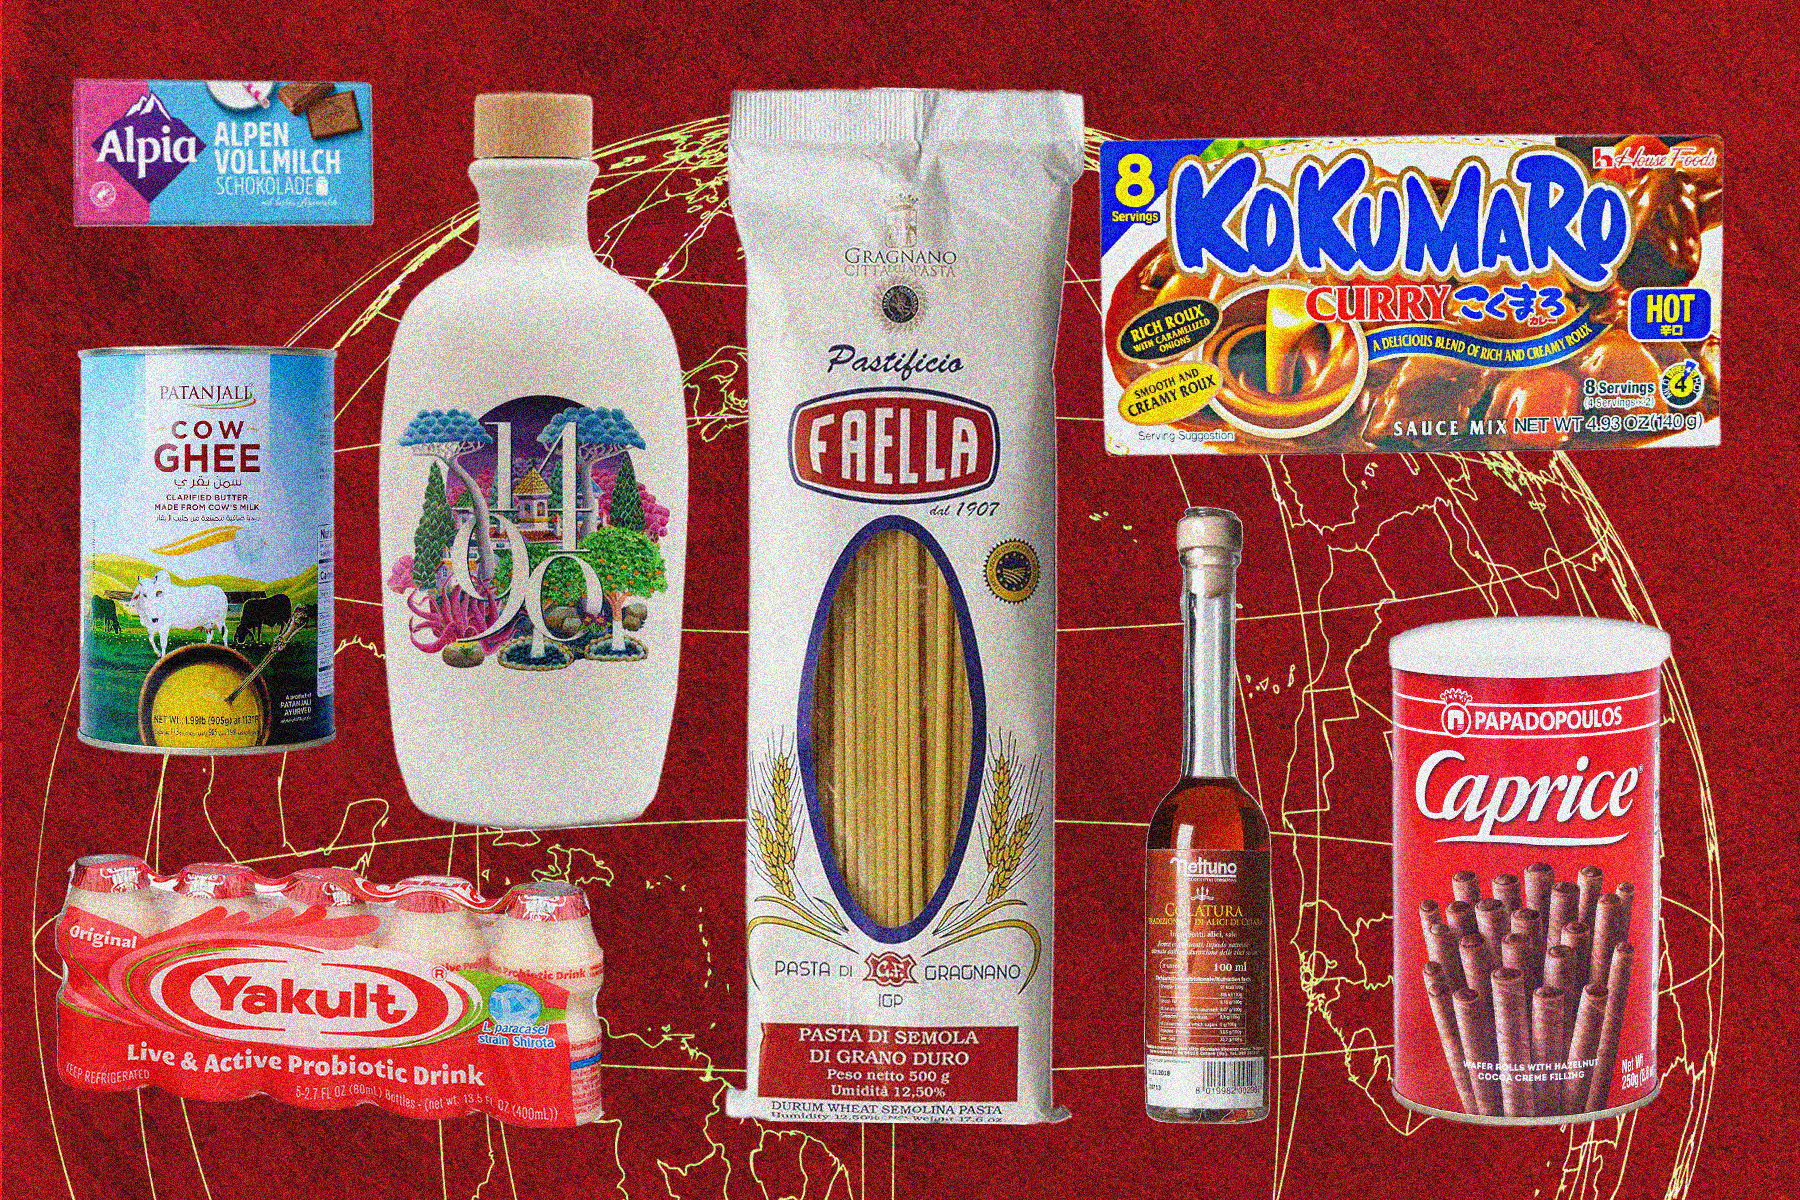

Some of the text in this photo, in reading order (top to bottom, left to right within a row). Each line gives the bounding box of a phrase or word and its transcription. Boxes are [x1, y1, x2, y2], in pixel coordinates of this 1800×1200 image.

[214, 122, 289, 147] ALPEN
[96, 124, 198, 179] Alpia
[1615, 146, 1717, 168] House Foods
[214, 149, 341, 175] VOLLMILCH
[216, 176, 313, 196] SCHOKOLADE
[1114, 153, 1156, 208] 8
[1111, 210, 1160, 224] Servings
[1306, 285, 1451, 322] CURRY
[1454, 282, 1566, 321] こくまろ
[1646, 294, 1695, 323] HOT
[1130, 304, 1205, 342] RICH ROUX
[1660, 325, 1683, 336] 辛口
[1133, 318, 1211, 354] WITH CARAMELIZED
[1159, 336, 1191, 353] ONIONS
[1373, 323, 1593, 361] A DELICIOUS BLEND OF RICH AND CREAMY ROUX
[827, 344, 963, 381] Pastificio
[1134, 368, 1199, 399] SMOOTH AND
[1584, 378, 1656, 396] 8 Servings
[1674, 375, 1688, 393] 4
[160, 385, 251, 403] PATANJALI
[1127, 374, 1217, 418] CREAMY ROUX
[171, 420, 245, 439] COW
[1393, 415, 1622, 436] SAUCE MIX NET WT 4.93
[809, 407, 978, 485] FAELLA
[1138, 430, 1234, 443] Serving Suggestion
[154, 443, 261, 473] GHEE
[154, 503, 260, 511] MADE FROM COW'S MILK
[929, 501, 1000, 518] dal 1907
[153, 715, 167, 724] NET
[1474, 705, 1622, 731] PAPADOPOULOS
[1415, 749, 1638, 838] Caprice
[1164, 902, 1243, 918] CATURA
[69, 923, 138, 949] Original
[555, 968, 586, 980] Drink
[774, 960, 853, 977] PASTA DI
[924, 964, 1021, 981] GRAGNANO
[1213, 961, 1247, 972] 100 ml
[204, 974, 408, 1024] Yakult
[878, 993, 903, 1008] IGP
[482, 1021, 492, 1033] L.
[799, 1027, 979, 1046] PASTA DI SEMOLA
[478, 1033, 509, 1046] strain
[512, 1035, 556, 1048] Shirota
[127, 1041, 485, 1086] Live & Active Probiotic Drink
[809, 1049, 970, 1066] DI GRANO DURO
[1463, 1058, 1599, 1072] WAFER ROLLS WITH HAZELNUT
[1621, 1057, 1634, 1073] Net
[66, 1062, 150, 1085] KEEP REFRIGERATED
[826, 1068, 950, 1085] Peso netto 500 g
[1477, 1070, 1585, 1082] COCOA CREME FILLING
[1621, 1072, 1638, 1090] 250g
[295, 1085, 318, 1100] 5-2.7
[321, 1087, 332, 1100] FL
[334, 1085, 346, 1098] OZ
[349, 1083, 382, 1097] (80mL)
[385, 1089, 416, 1109] Bottles
[831, 1083, 946, 1099] Umidità 12,50%
[771, 1100, 1002, 1116] DURUM WHEAT SEMOLINA PASTA
